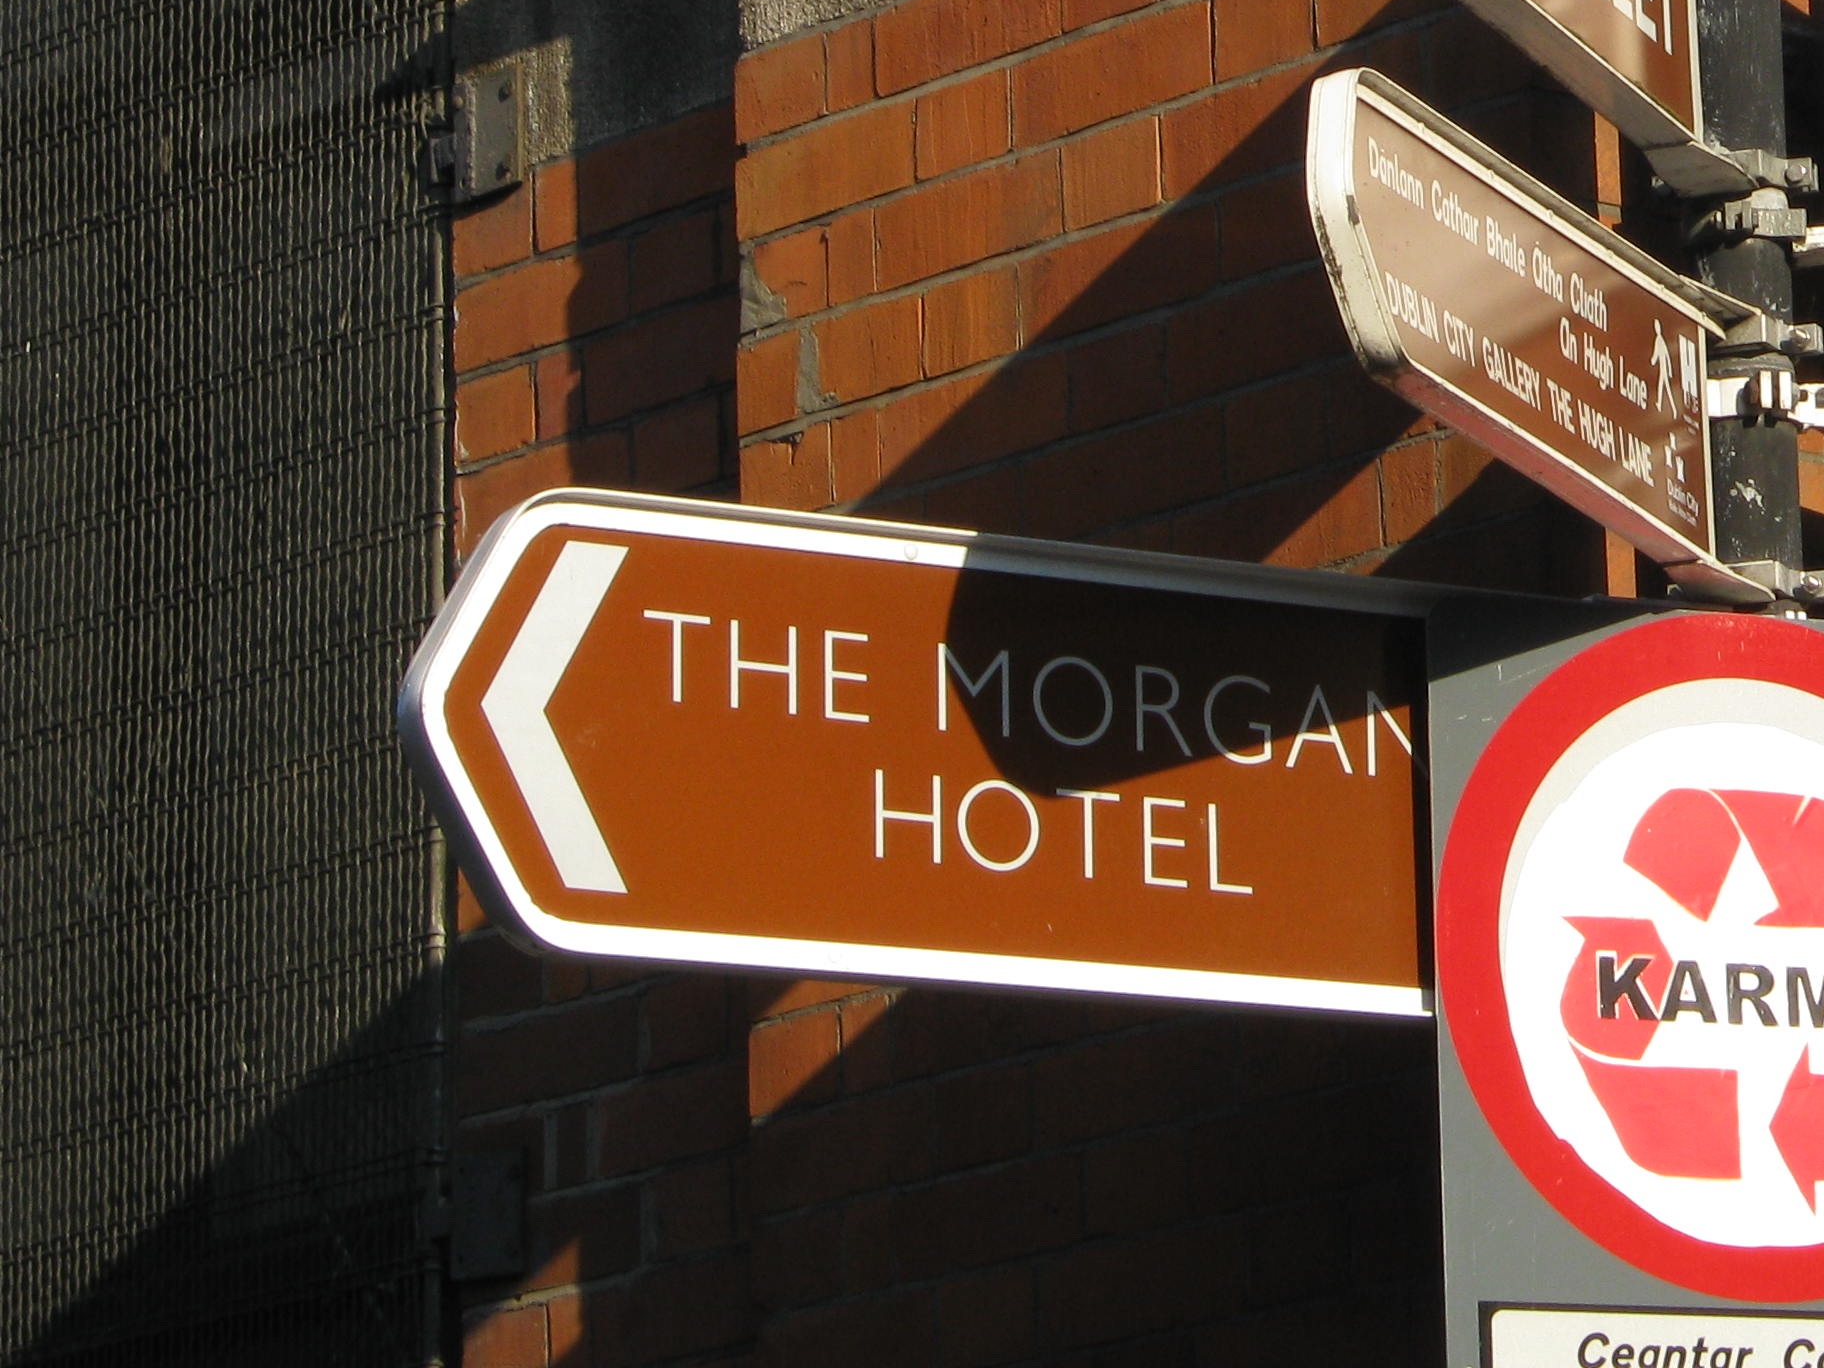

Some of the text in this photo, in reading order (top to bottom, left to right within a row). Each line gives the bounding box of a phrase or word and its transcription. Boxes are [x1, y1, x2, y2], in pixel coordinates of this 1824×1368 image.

[1384, 271, 1655, 488] DUBLIN CITY GALLERY THE HUGH LANE
[1584, 332, 1614, 390] Hugh
[1619, 355, 1648, 410] Lane
[643, 609, 1427, 778] THE MORGAN
[875, 769, 1254, 895] HOTEL
[1578, 1332, 1753, 1368] Ceantar
